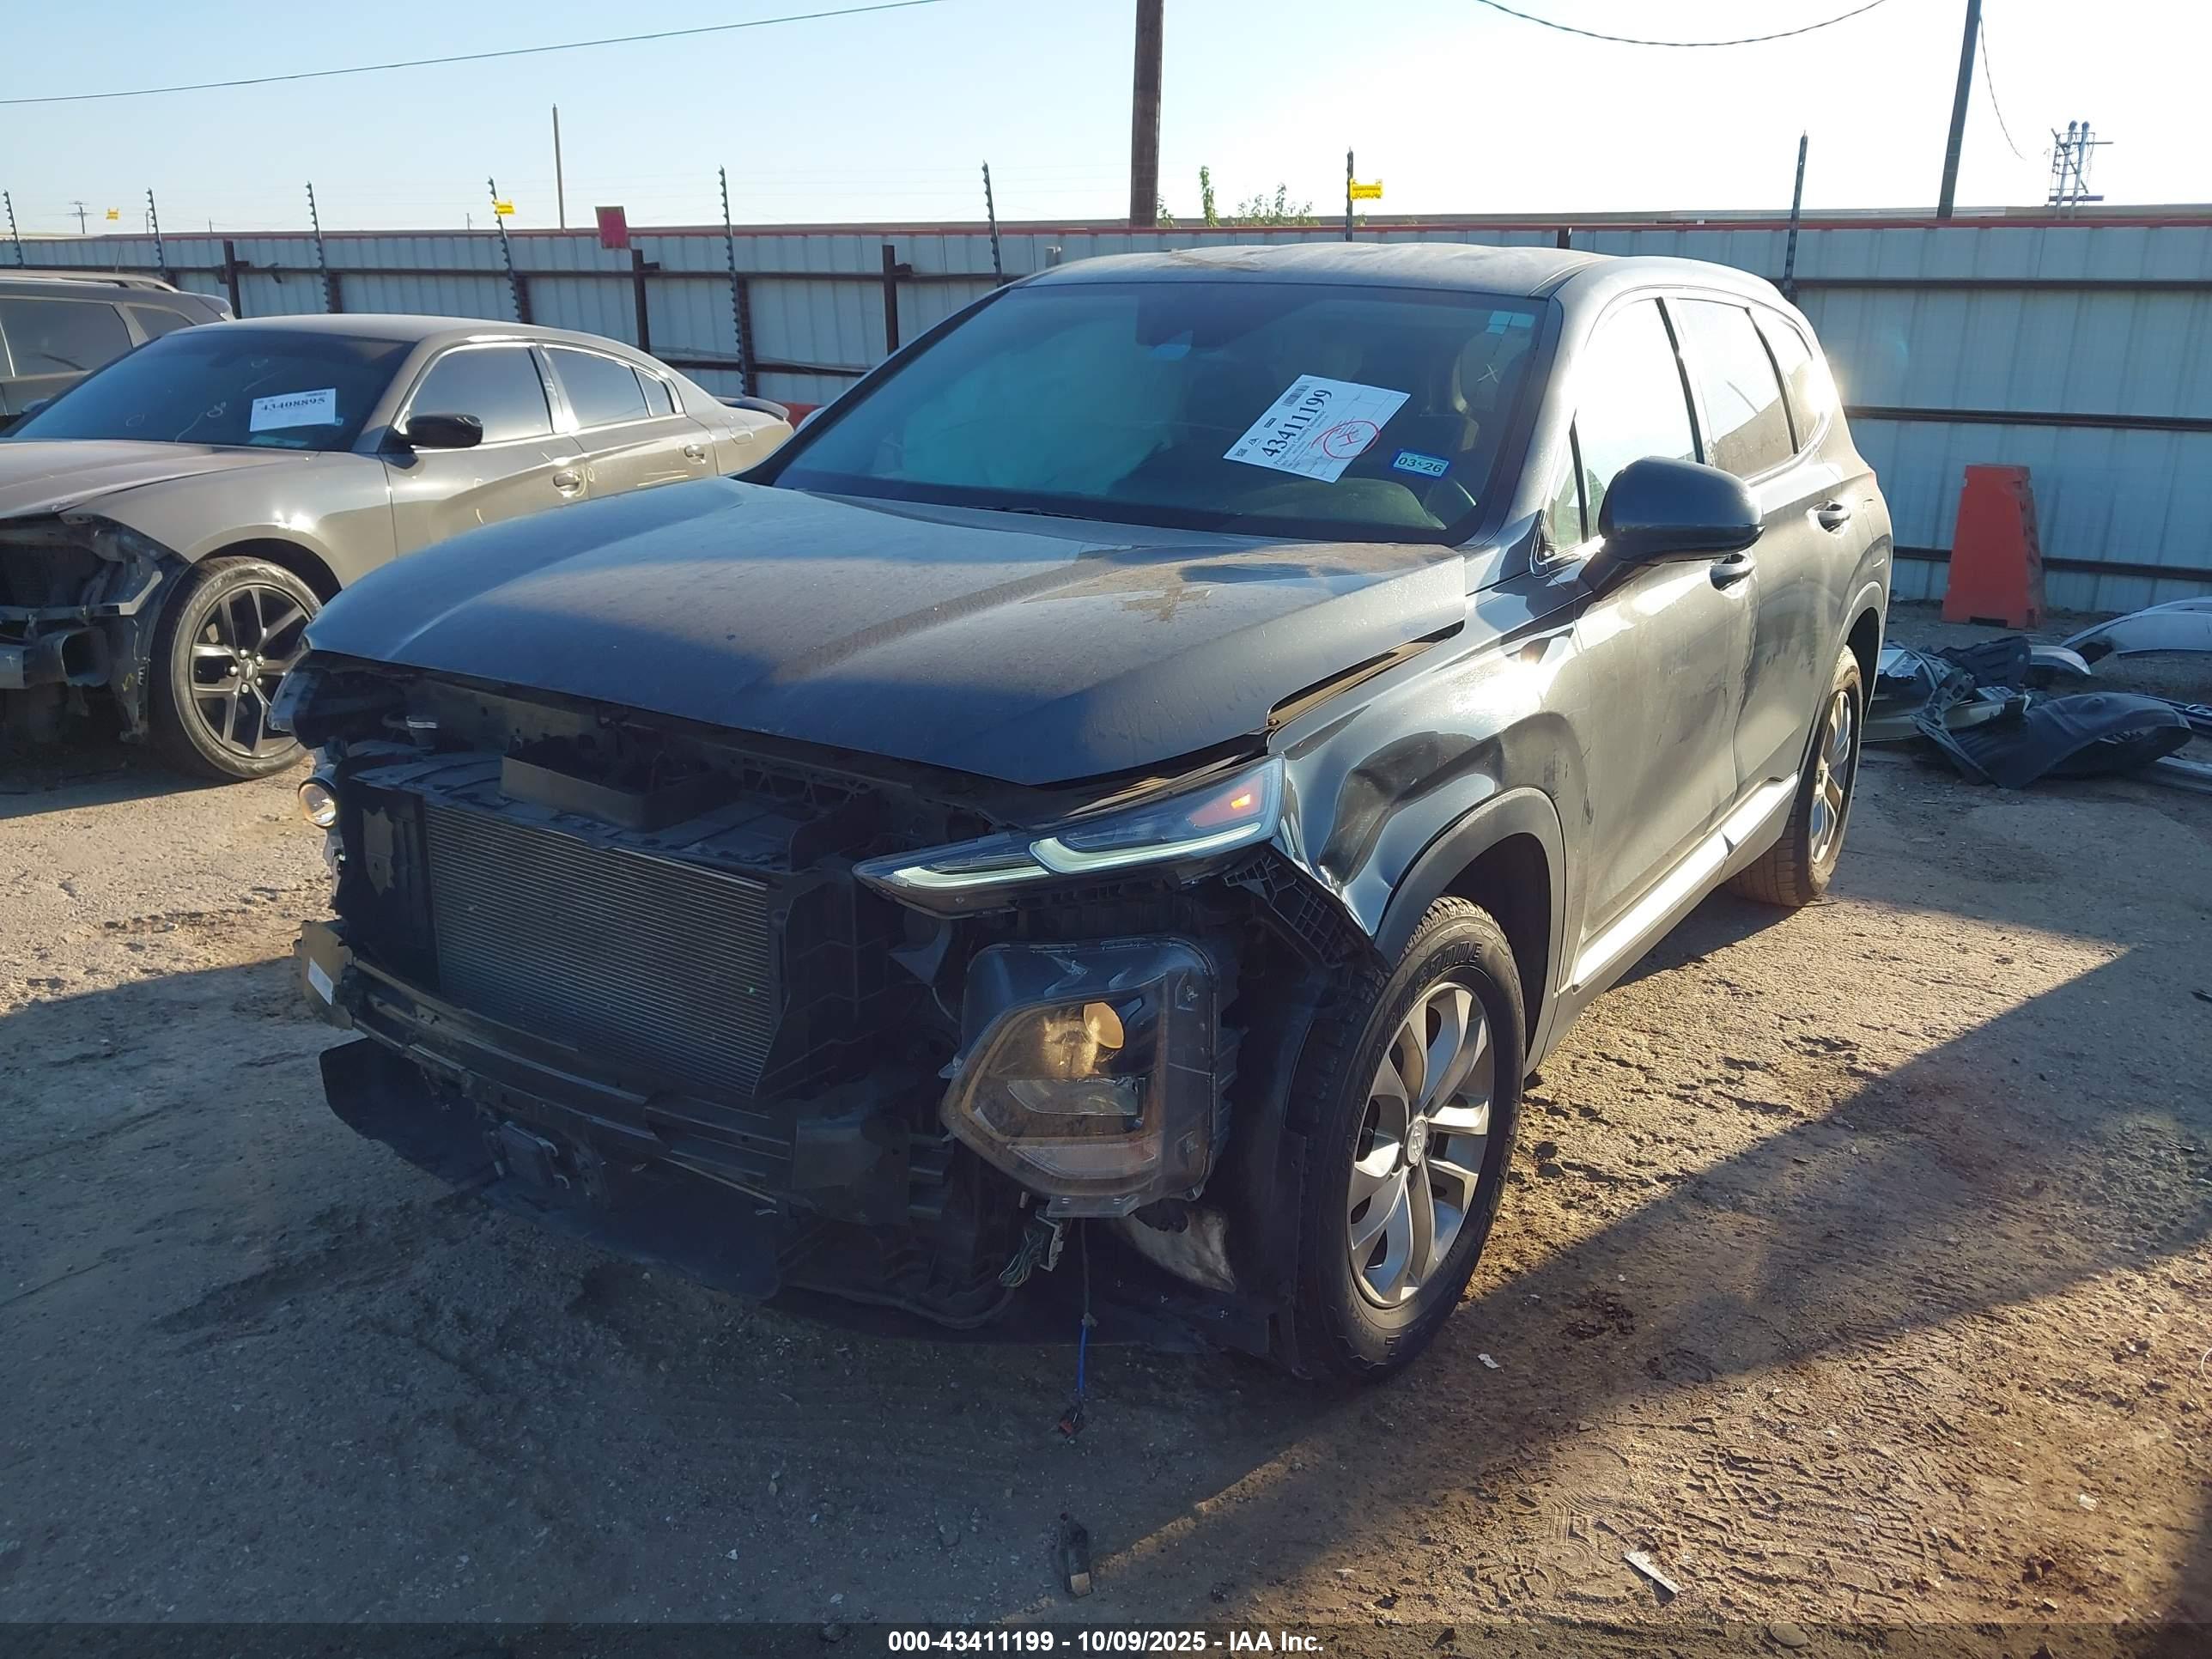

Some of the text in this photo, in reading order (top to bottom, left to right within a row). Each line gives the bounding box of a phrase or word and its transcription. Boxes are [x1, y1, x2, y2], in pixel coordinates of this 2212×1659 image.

[1262, 390, 1332, 457] 43411199
[1398, 457, 1443, 472] 03 26
